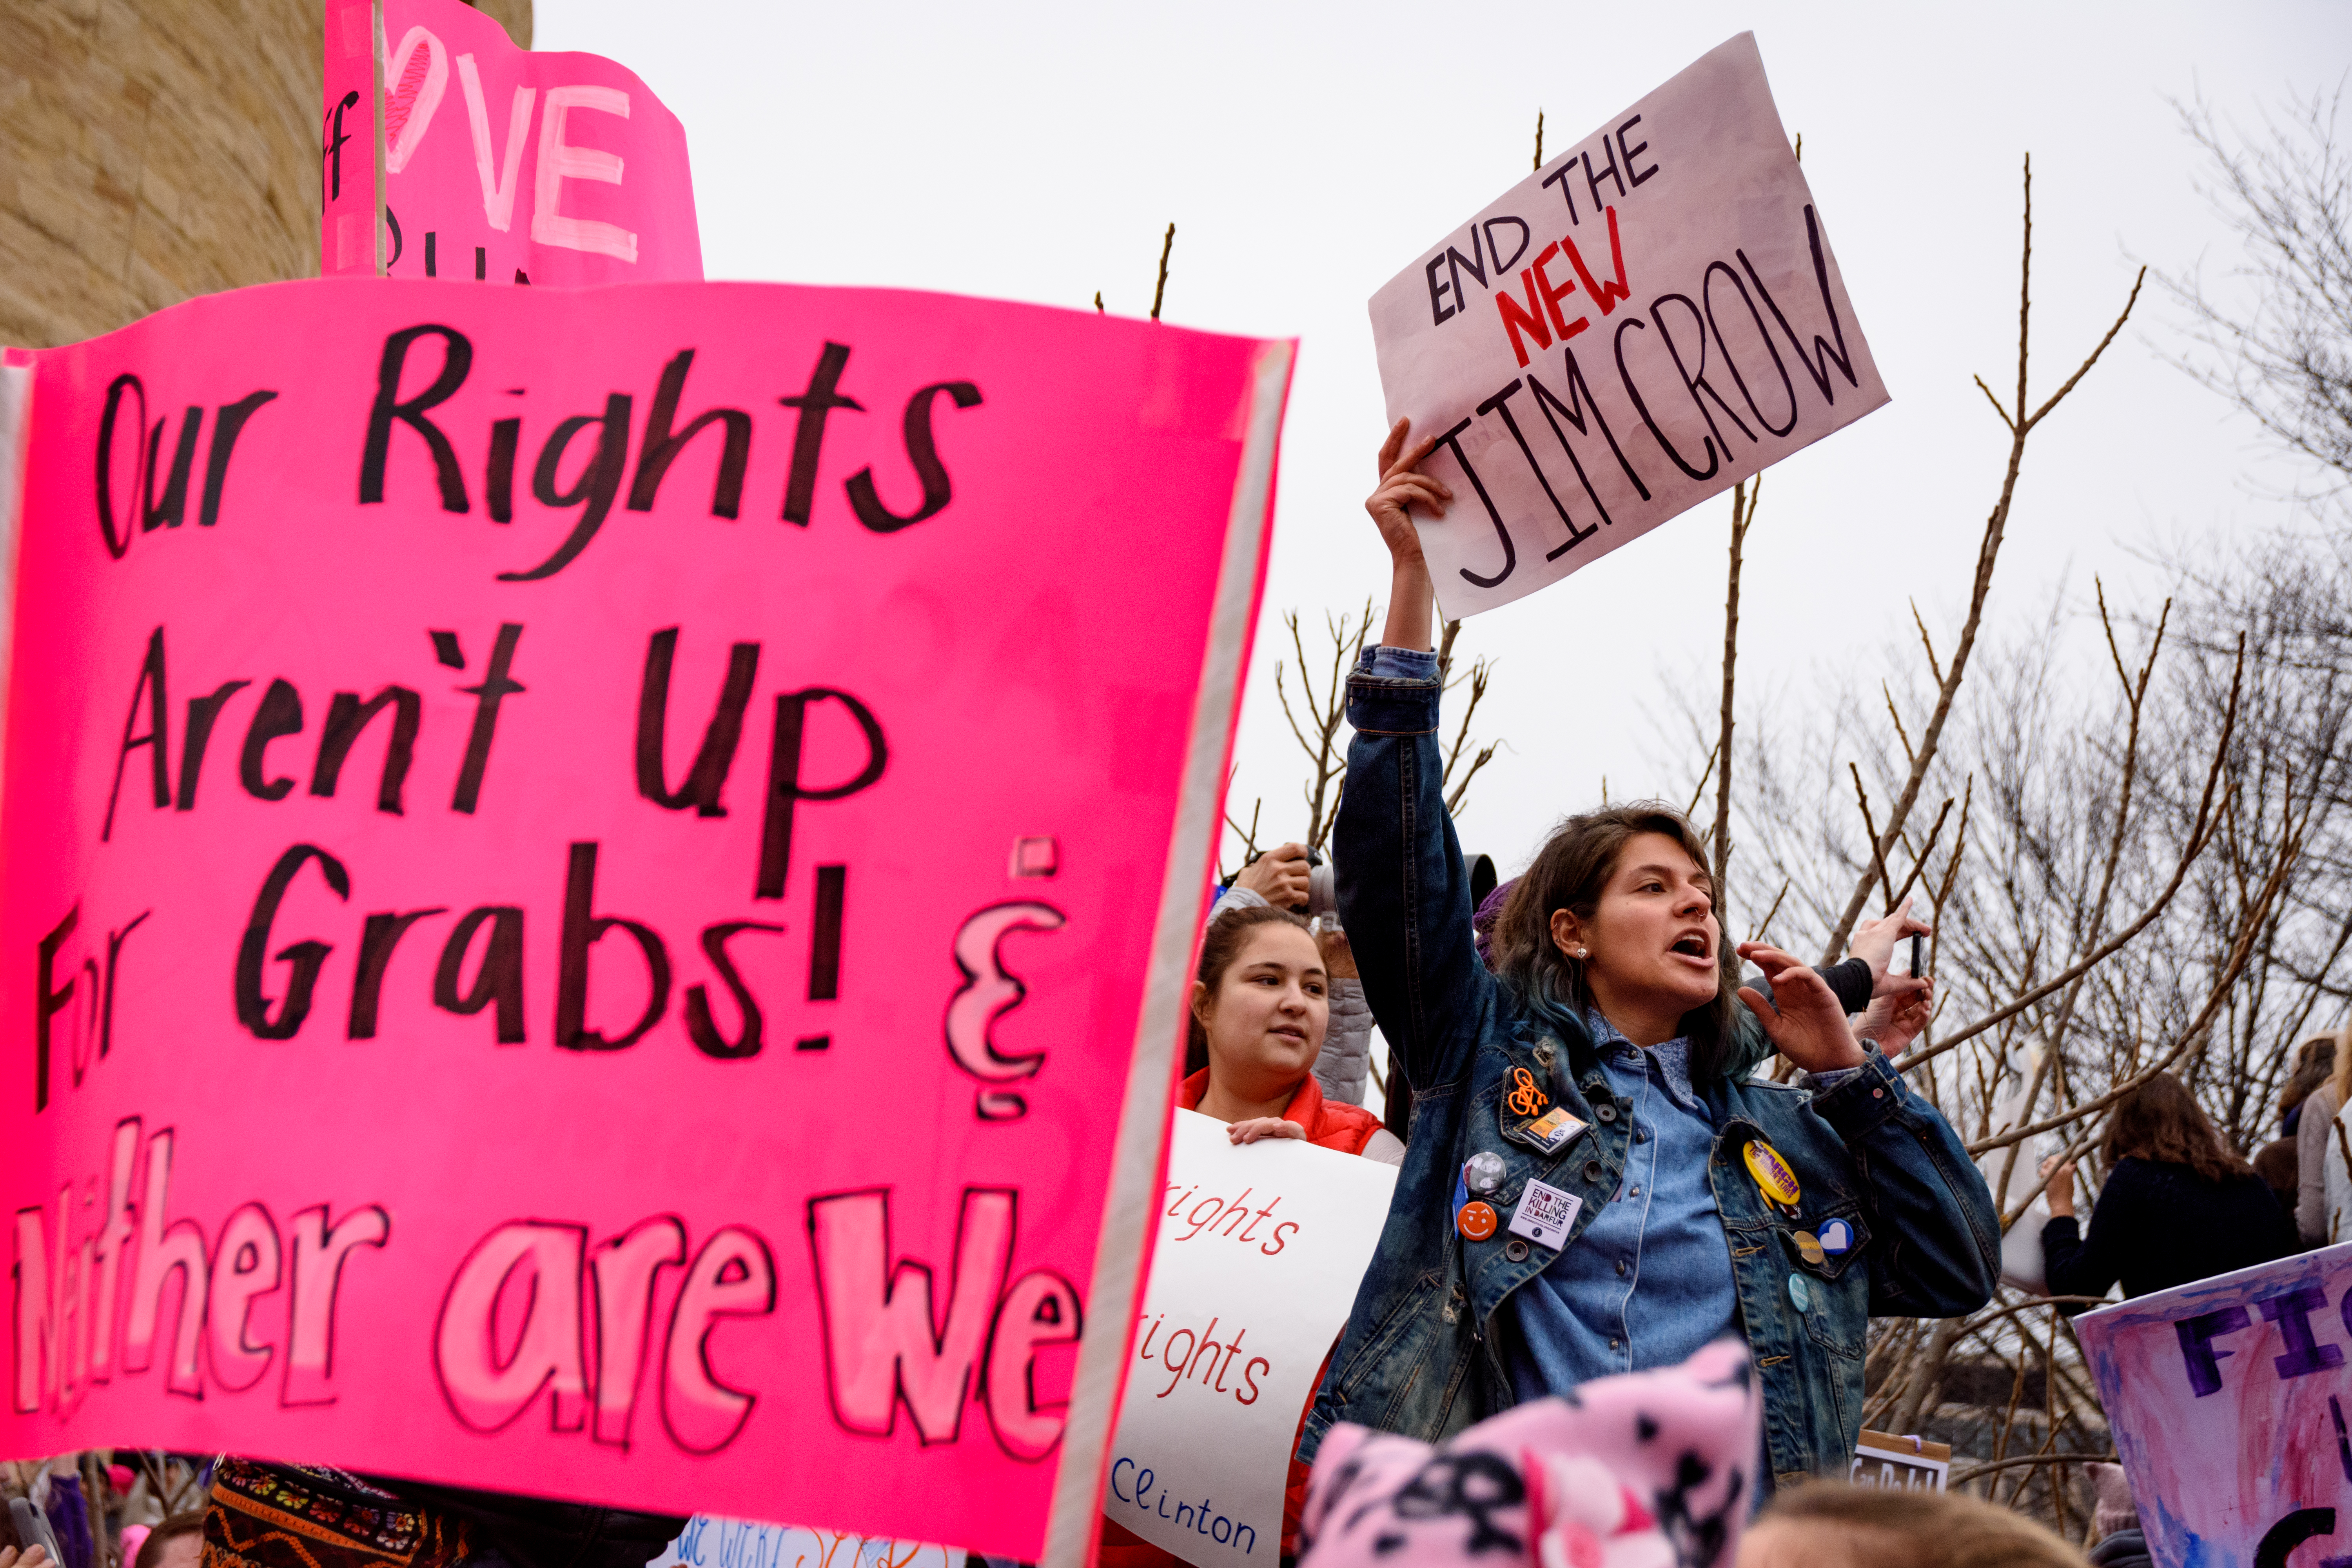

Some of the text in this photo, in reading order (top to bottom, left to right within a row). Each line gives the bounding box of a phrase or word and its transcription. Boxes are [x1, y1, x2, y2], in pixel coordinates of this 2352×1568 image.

[1426, 114, 1659, 326] END THE
[1495, 205, 1631, 368] NEW
[96, 323, 984, 583] Our Rights
[1423, 203, 1858, 588] JIM CROW
[102, 623, 888, 899] Aren't Up
[36, 900, 151, 1115] For
[235, 841, 847, 1061] Grabs!
[1525, 1206, 1563, 1227] IN DARFUR
[1528, 1197, 1567, 1220] KILLING
[1532, 1188, 1572, 1211] END THE
[1780, 1182, 1794, 1198] LIVES
[11, 1115, 1083, 1464] Neither are We
[1138, 1313, 1270, 1405] ights
[1111, 1457, 1256, 1555] Clinton
